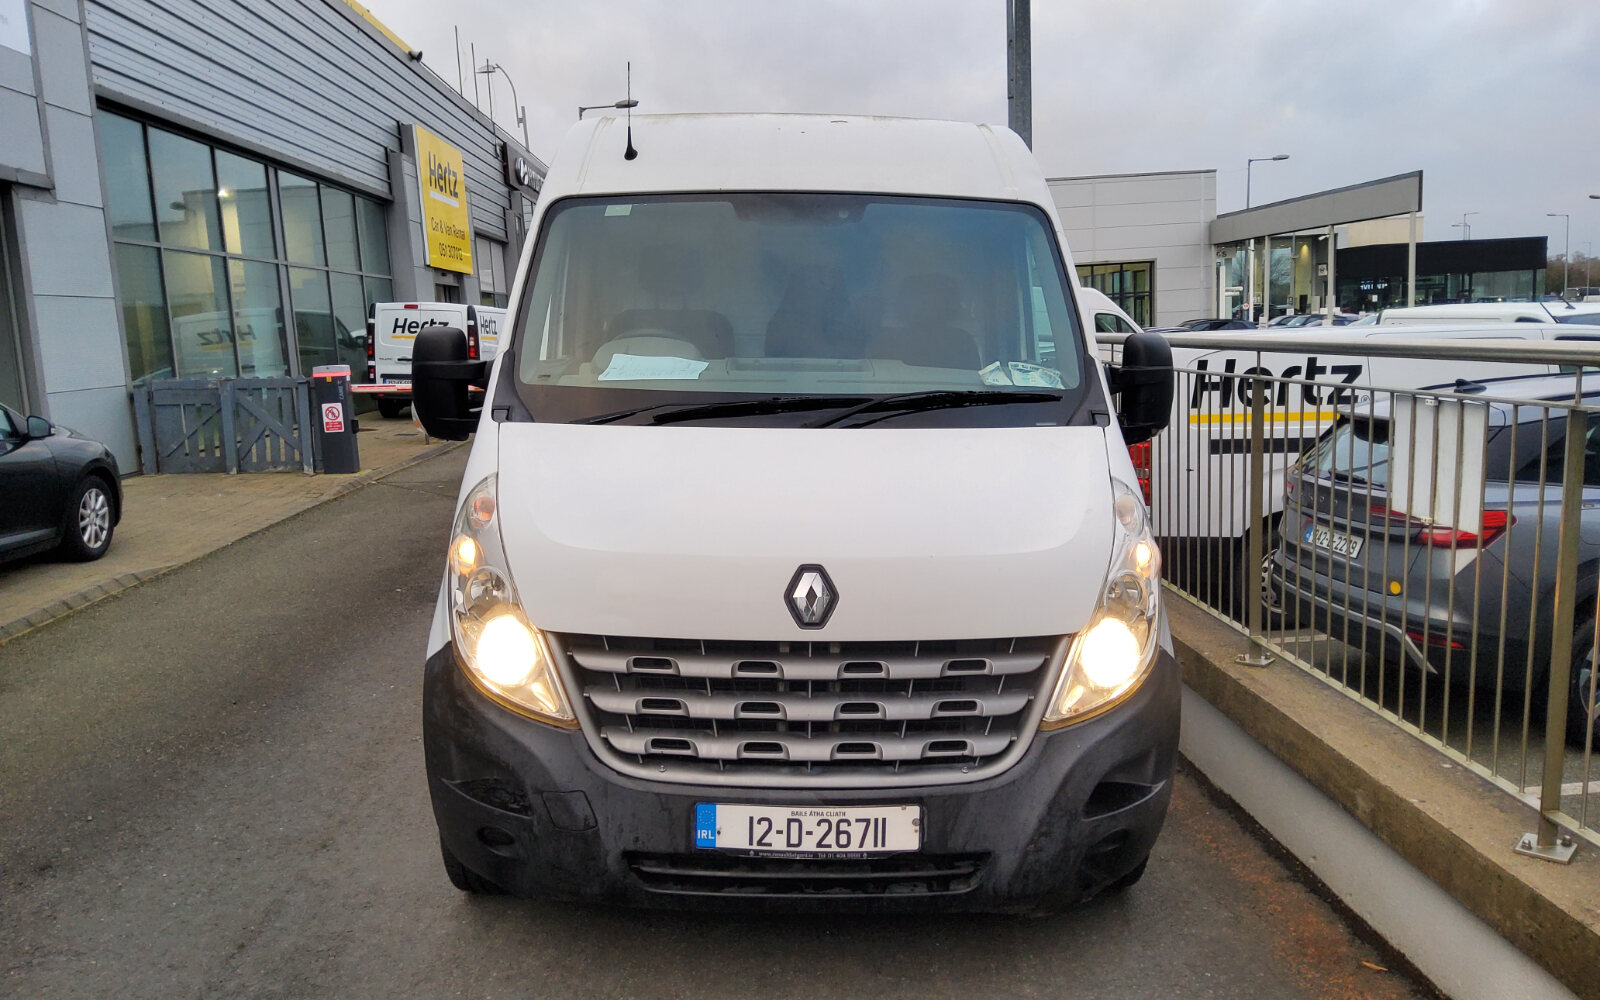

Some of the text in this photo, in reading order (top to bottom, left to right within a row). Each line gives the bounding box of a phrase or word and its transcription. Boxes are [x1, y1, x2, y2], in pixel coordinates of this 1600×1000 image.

[428, 151, 459, 199] Hertz
[431, 217, 439, 232] Car
[444, 221, 452, 236] Van
[452, 224, 466, 241] Rental
[480, 316, 498, 336] Hertz
[1191, 357, 1362, 408] Hertz
[809, 809, 825, 817] ÁTHA
[697, 829, 715, 840] IRL
[748, 816, 887, 848] 12-D-26711
